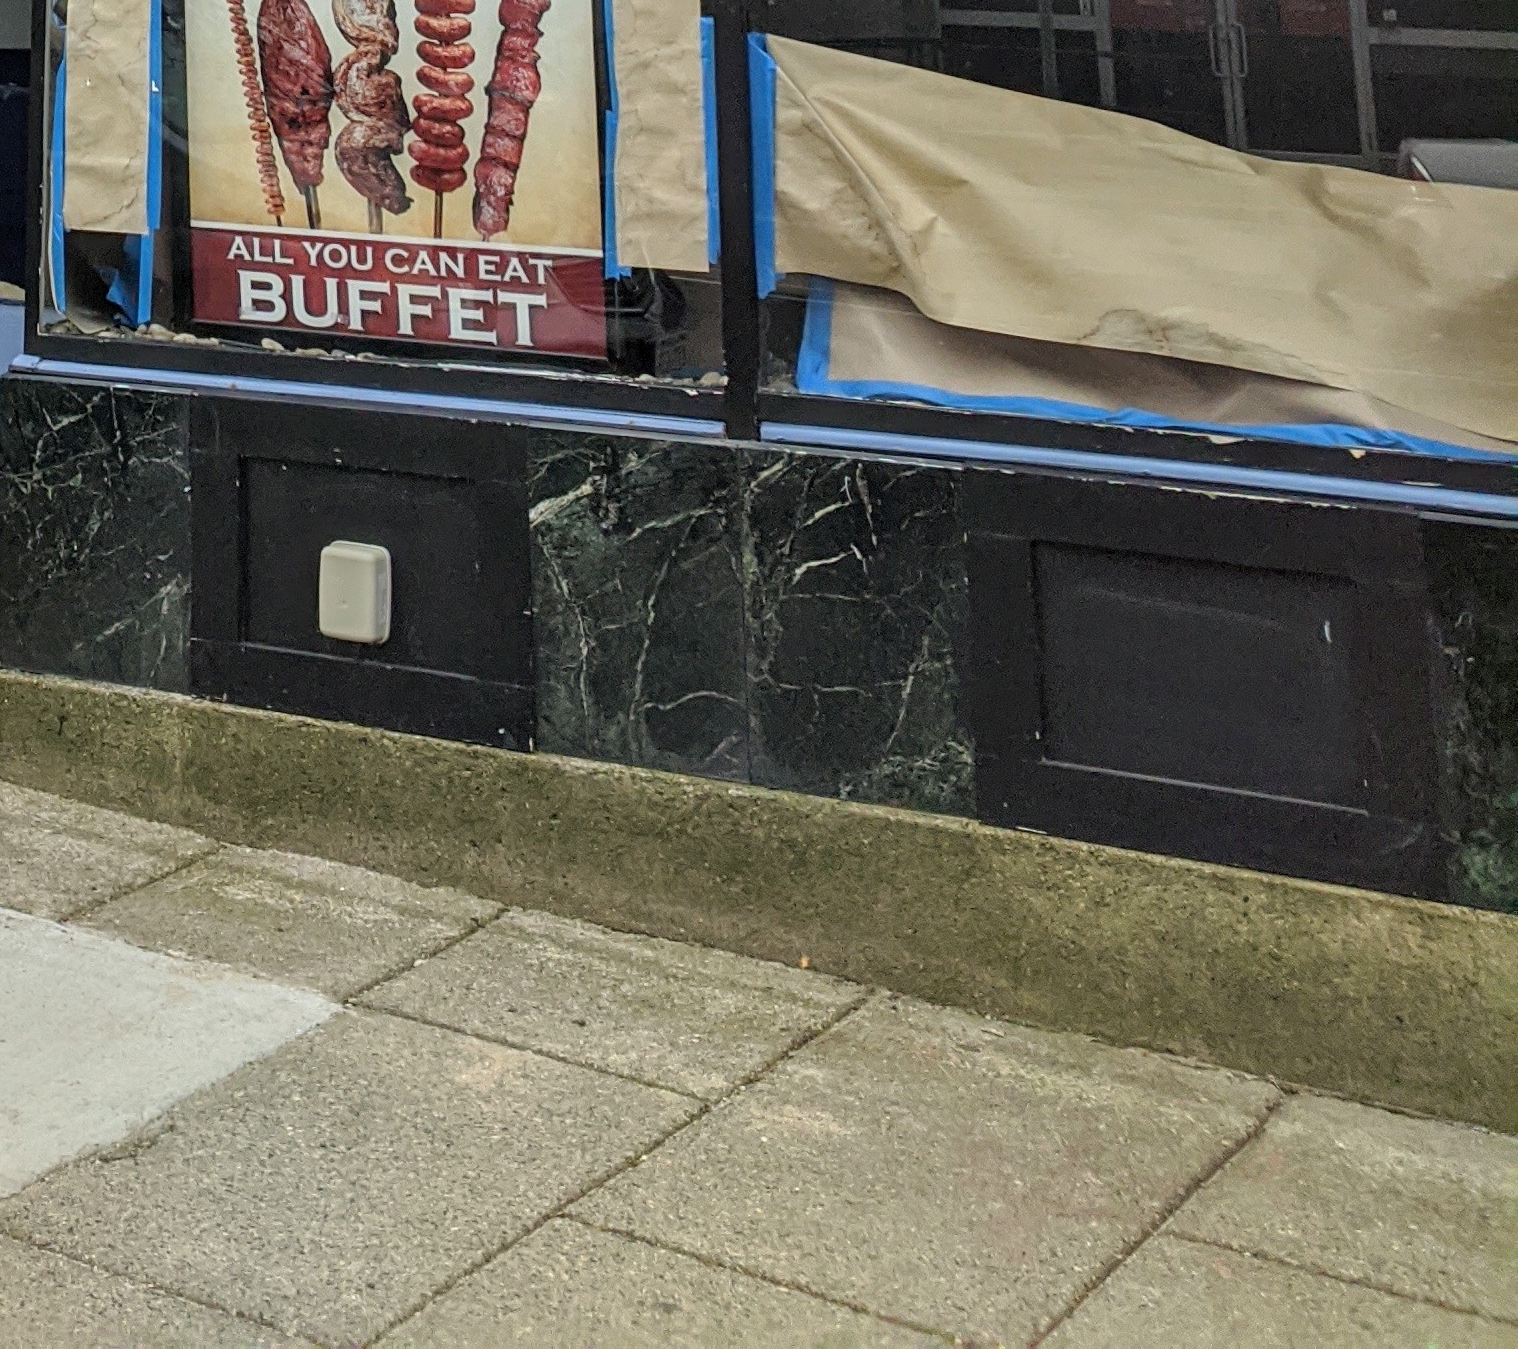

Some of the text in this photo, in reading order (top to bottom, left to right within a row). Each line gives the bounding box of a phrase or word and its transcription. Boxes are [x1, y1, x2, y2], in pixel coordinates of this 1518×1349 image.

[227, 234, 553, 286] ALL YOU CAN EAT
[236, 268, 548, 348] BUFFET
